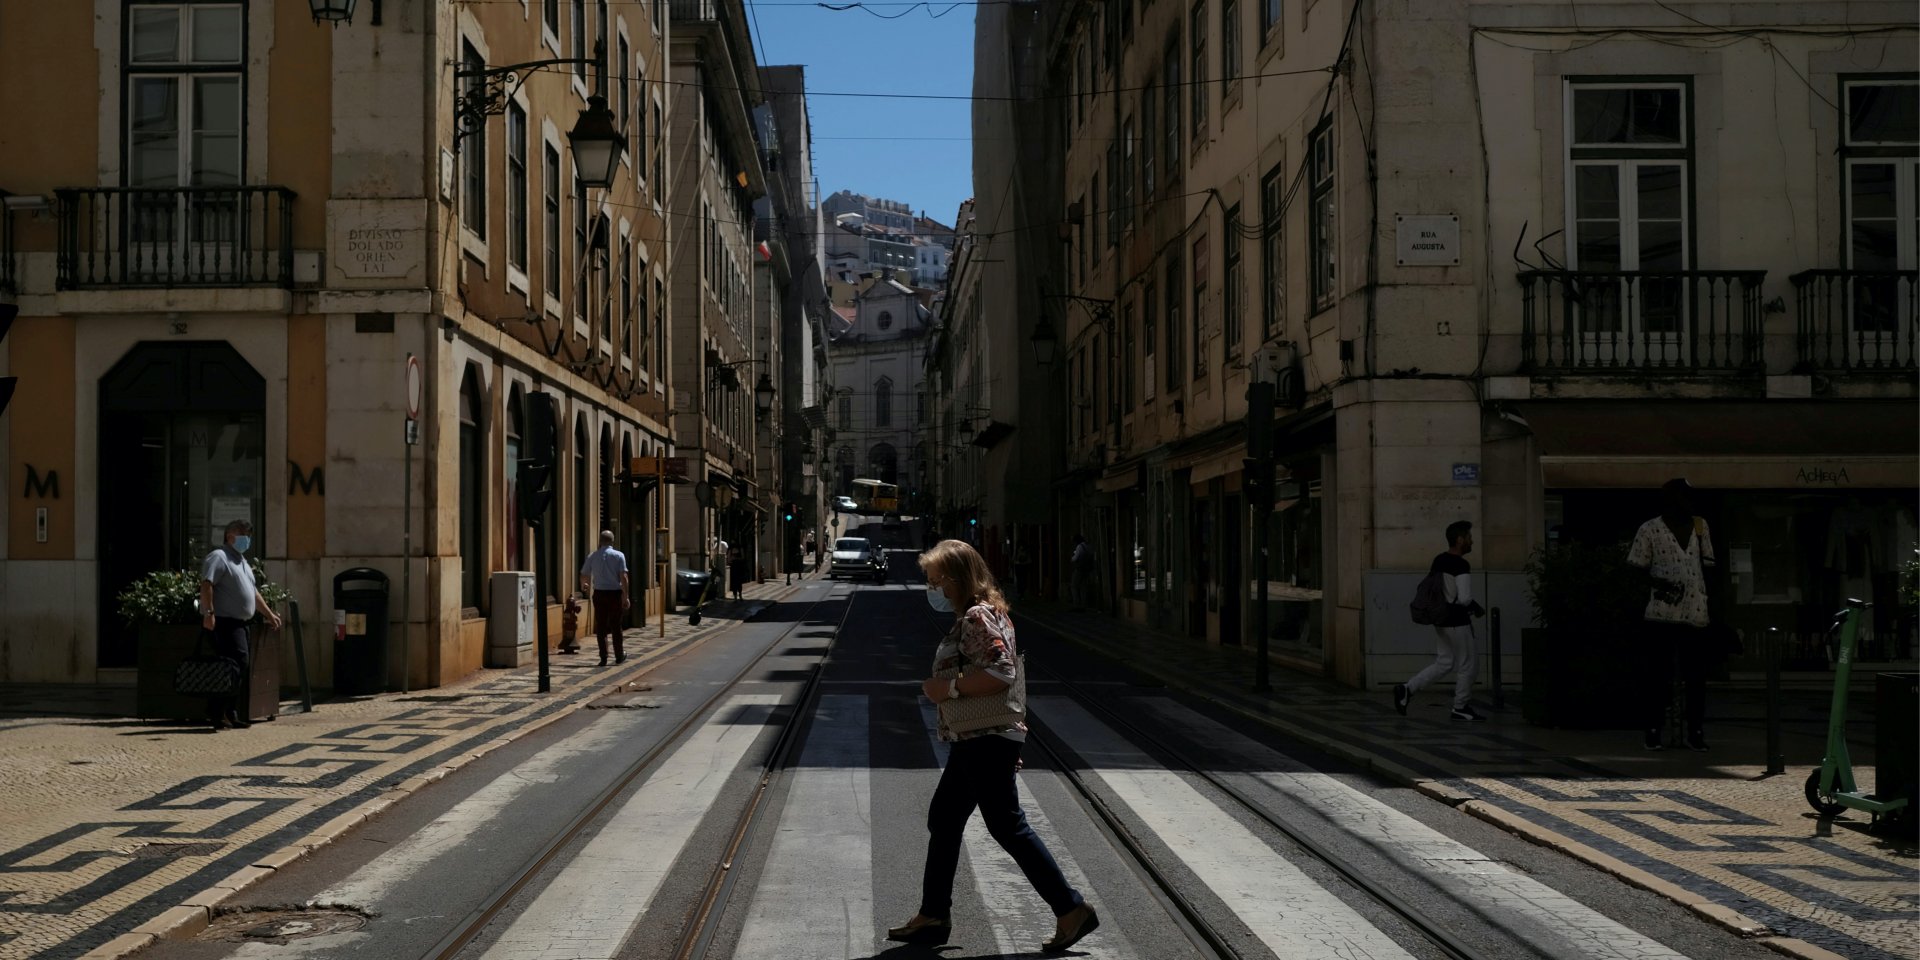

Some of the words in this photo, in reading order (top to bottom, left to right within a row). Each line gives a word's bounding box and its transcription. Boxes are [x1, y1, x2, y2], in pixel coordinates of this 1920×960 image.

[356, 252, 396, 262] ORIEN
[23, 463, 59, 499] M
[287, 460, 325, 496] M
